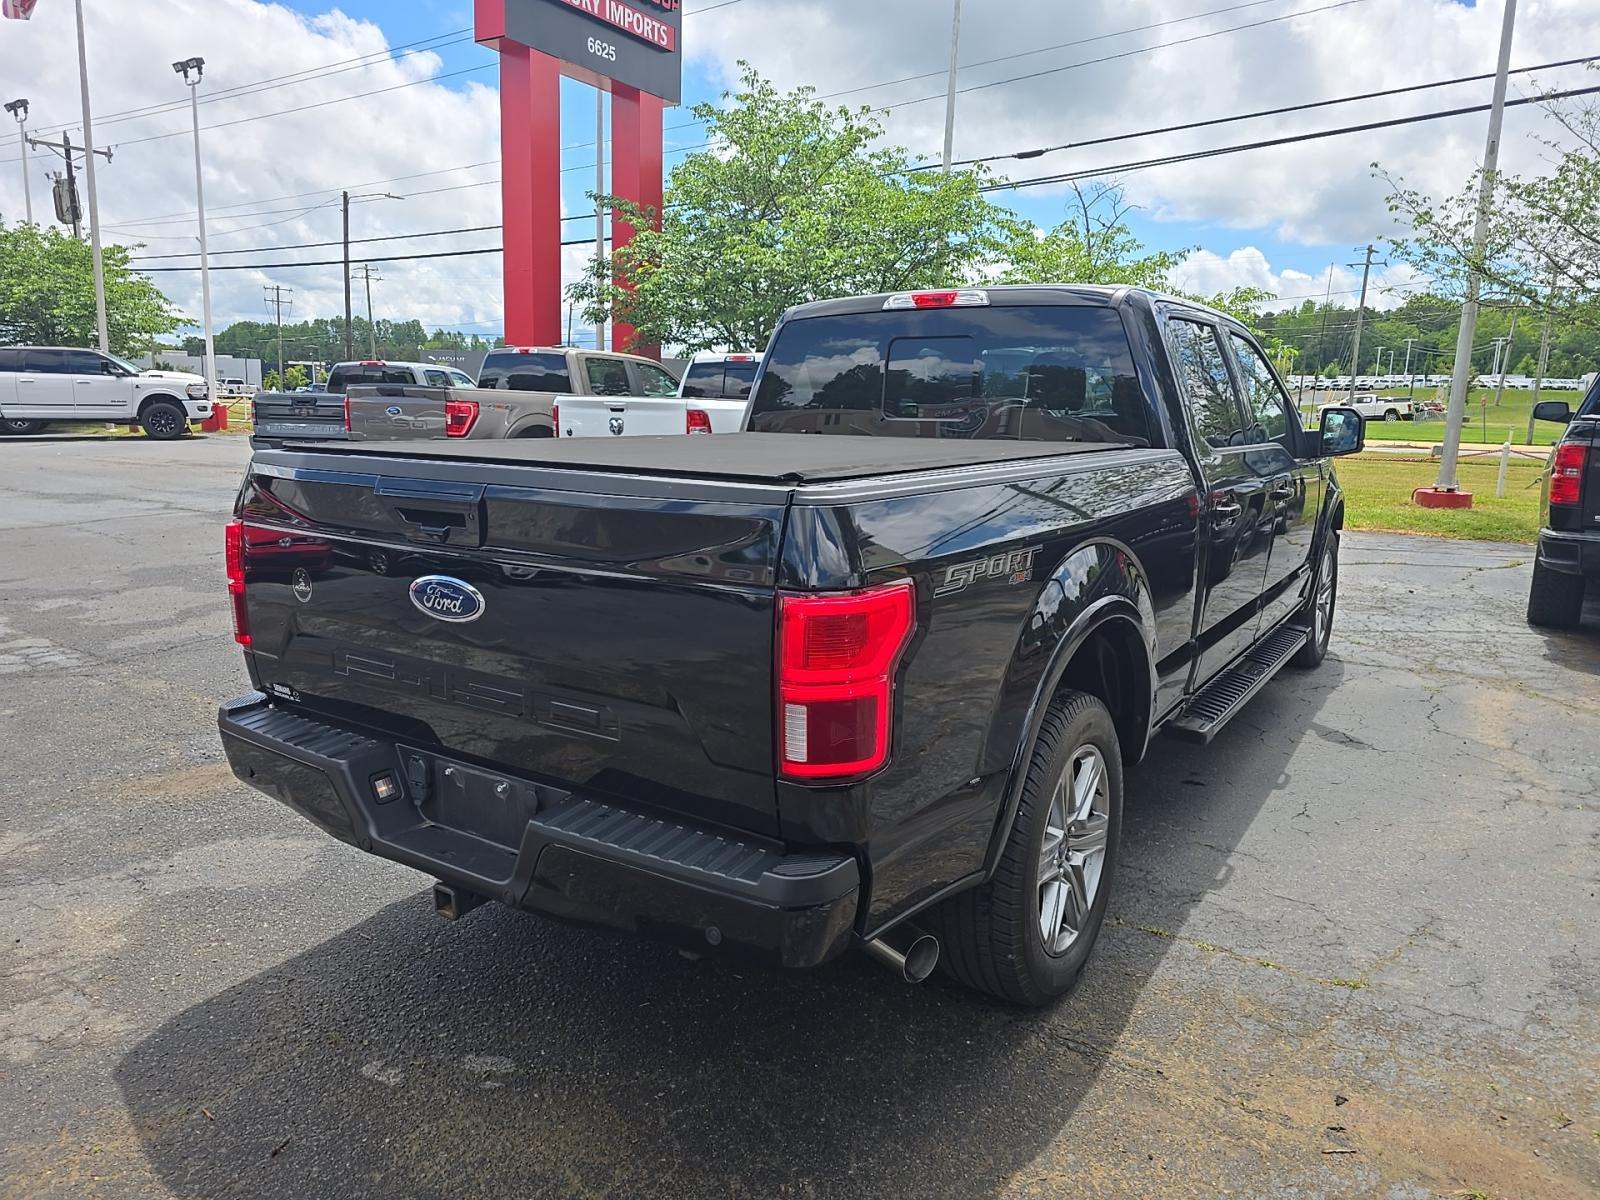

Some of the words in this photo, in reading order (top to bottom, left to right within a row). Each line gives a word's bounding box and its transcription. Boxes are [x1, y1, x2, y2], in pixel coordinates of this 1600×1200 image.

[606, 0, 668, 45] IMPORTS
[587, 36, 616, 61] 6625
[933, 543, 1043, 599] SPORT
[423, 584, 463, 613] Ford
